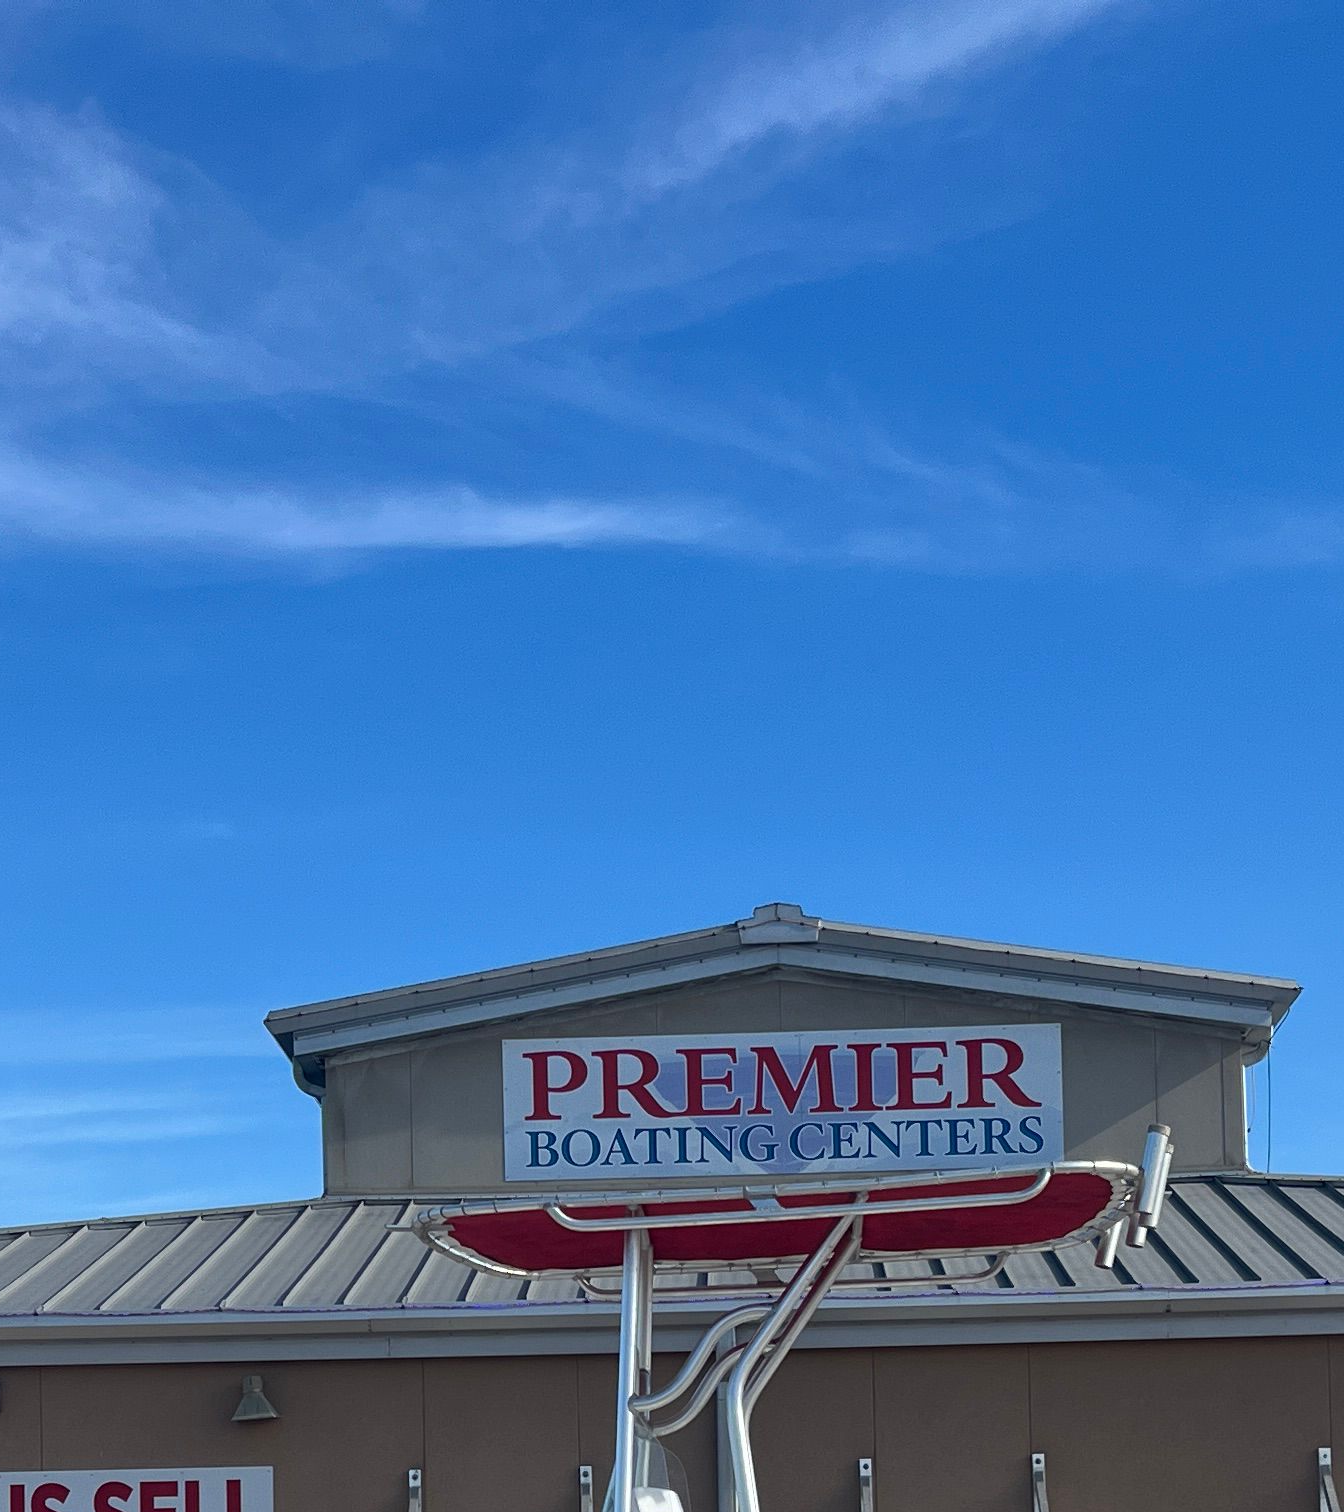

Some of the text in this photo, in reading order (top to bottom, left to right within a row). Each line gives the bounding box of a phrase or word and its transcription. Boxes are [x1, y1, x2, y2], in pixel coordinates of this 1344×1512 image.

[522, 1037, 1043, 1122] PREMIER
[524, 1115, 1044, 1169] BOATING CENTERS
